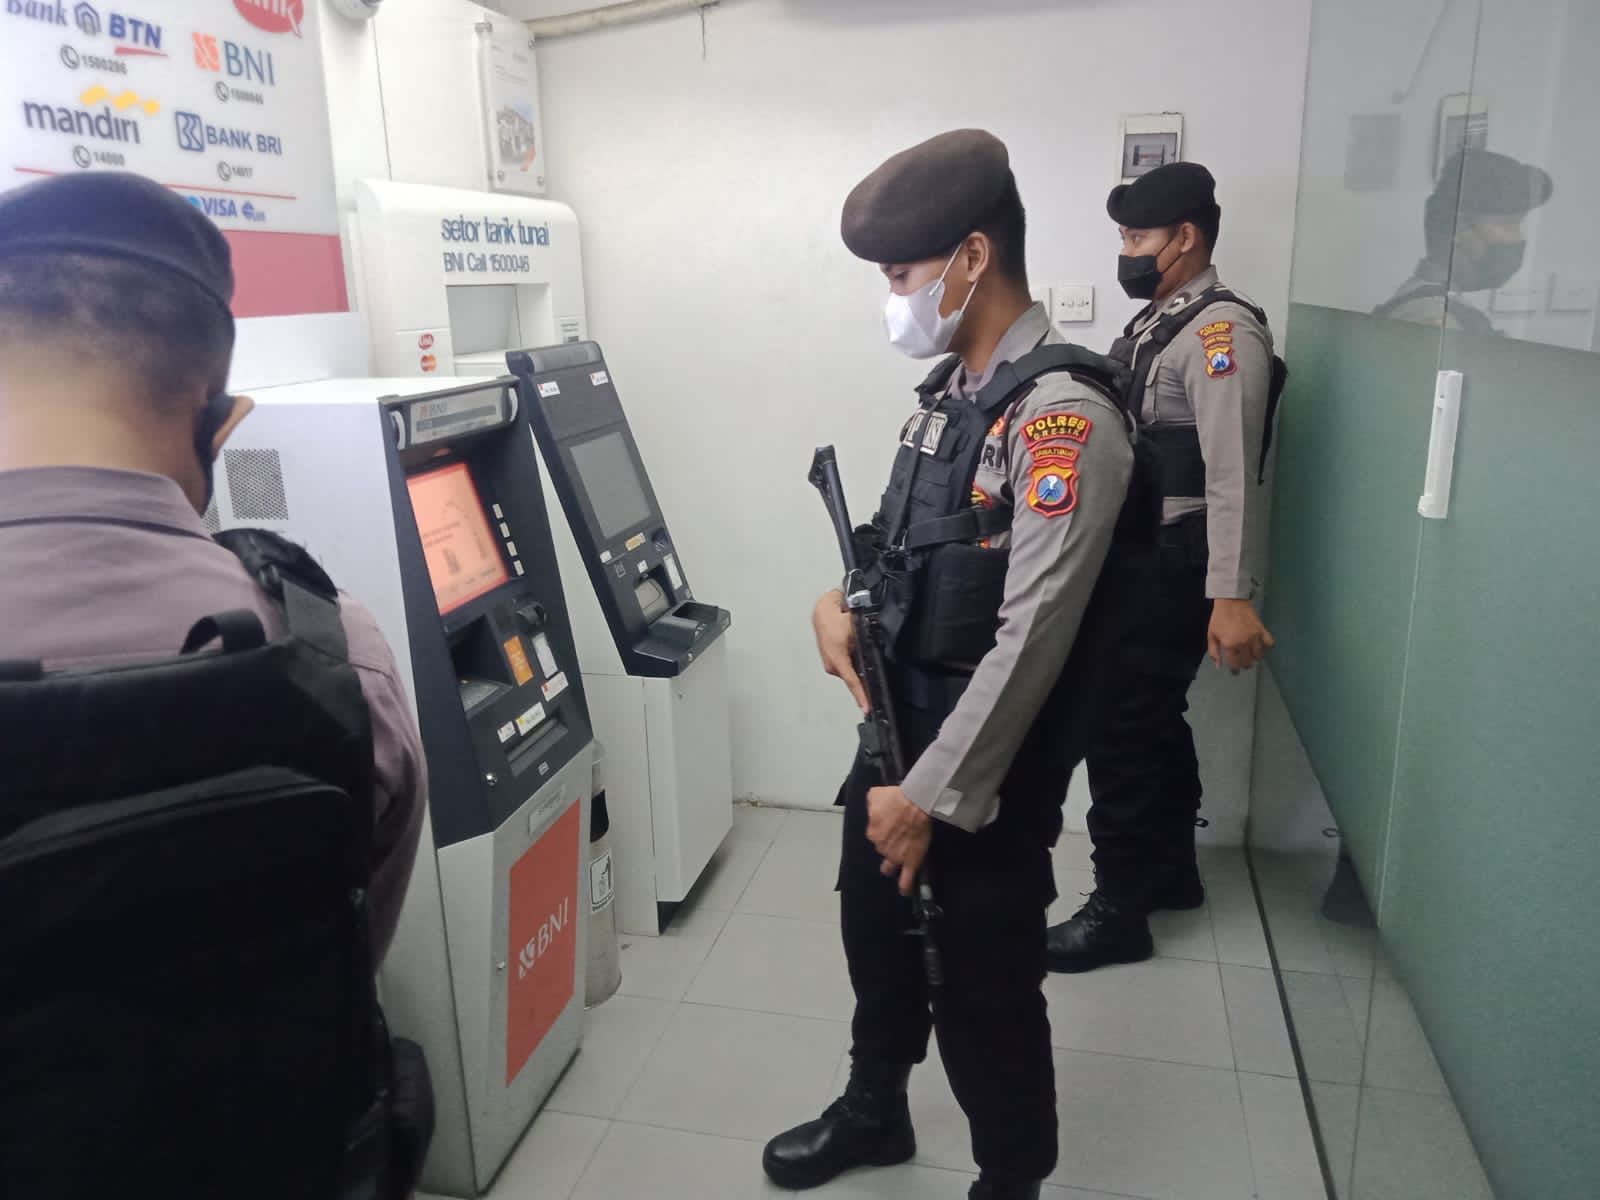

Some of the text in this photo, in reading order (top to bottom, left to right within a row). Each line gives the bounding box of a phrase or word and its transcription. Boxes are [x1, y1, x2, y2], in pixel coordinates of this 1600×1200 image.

[5, 0, 162, 49] Bank BTN
[223, 40, 276, 87] BNI
[23, 100, 141, 144] mandiri
[205, 125, 282, 156] BANK BRI
[201, 196, 238, 217] VISA
[441, 214, 550, 246] setor tarik tunai
[443, 252, 465, 272] BNI
[466, 252, 487, 272] Call
[1025, 415, 1086, 438] POLRES
[1033, 428, 1080, 441] GRESIK
[536, 896, 569, 959] BNI
